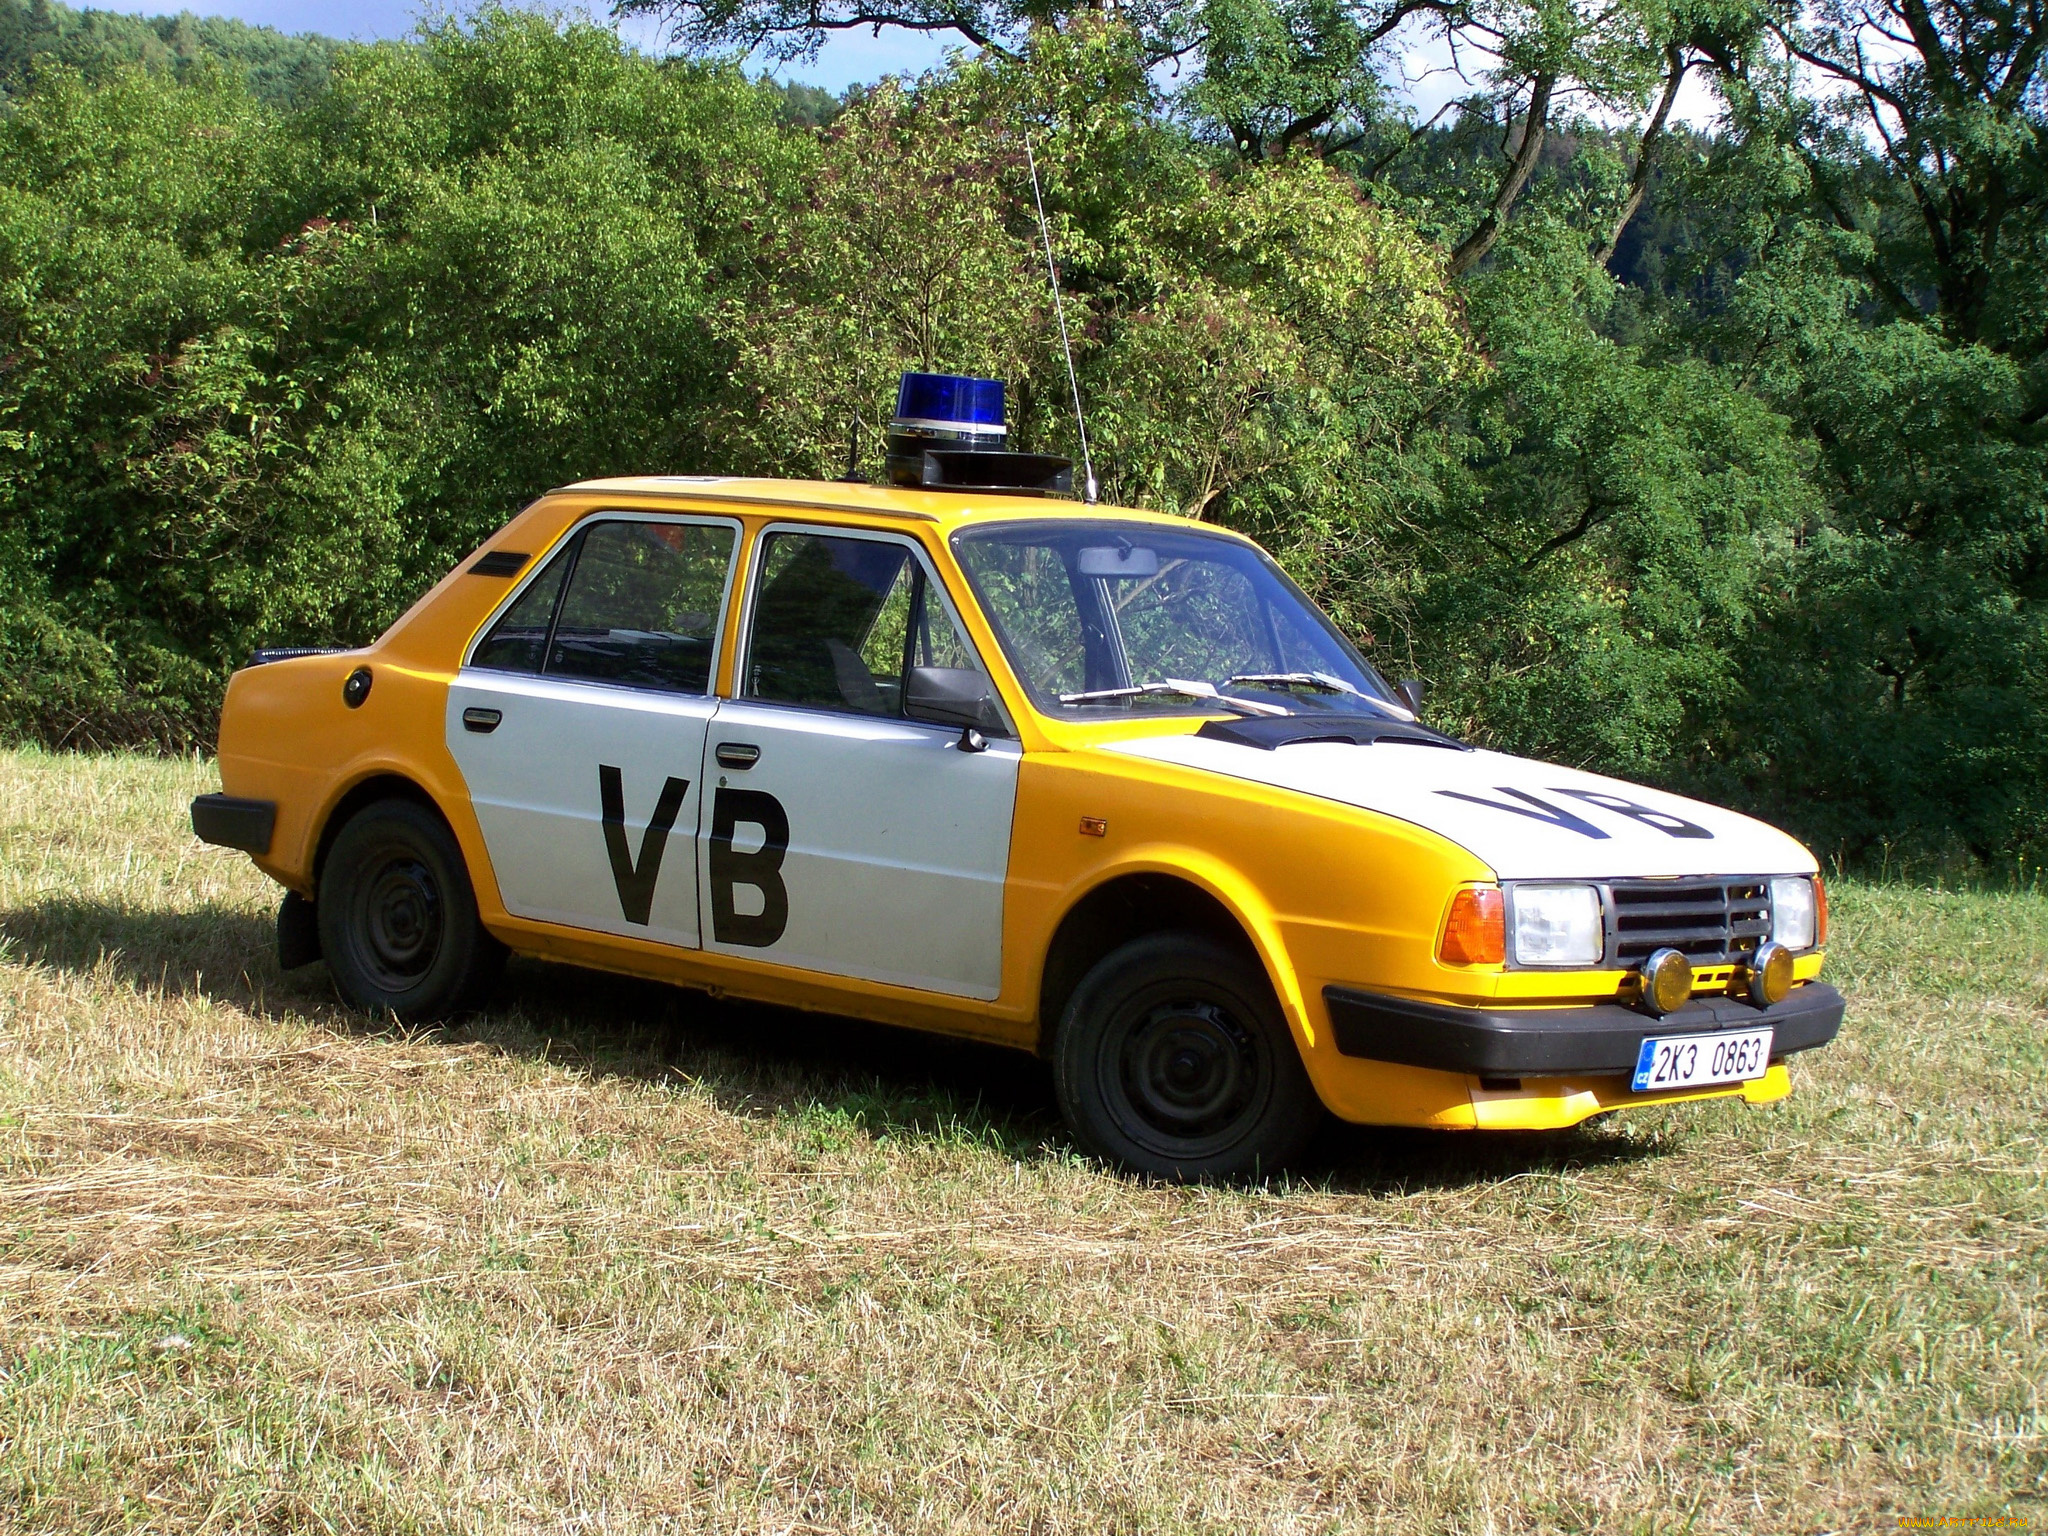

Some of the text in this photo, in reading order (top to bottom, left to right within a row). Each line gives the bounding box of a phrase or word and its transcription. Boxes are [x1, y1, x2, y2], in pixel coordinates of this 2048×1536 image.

[1431, 787, 1715, 839] VB
[599, 764, 789, 947] VB
[1636, 1073, 1649, 1084] CZ
[1655, 1038, 1761, 1082] 2K3 0863
